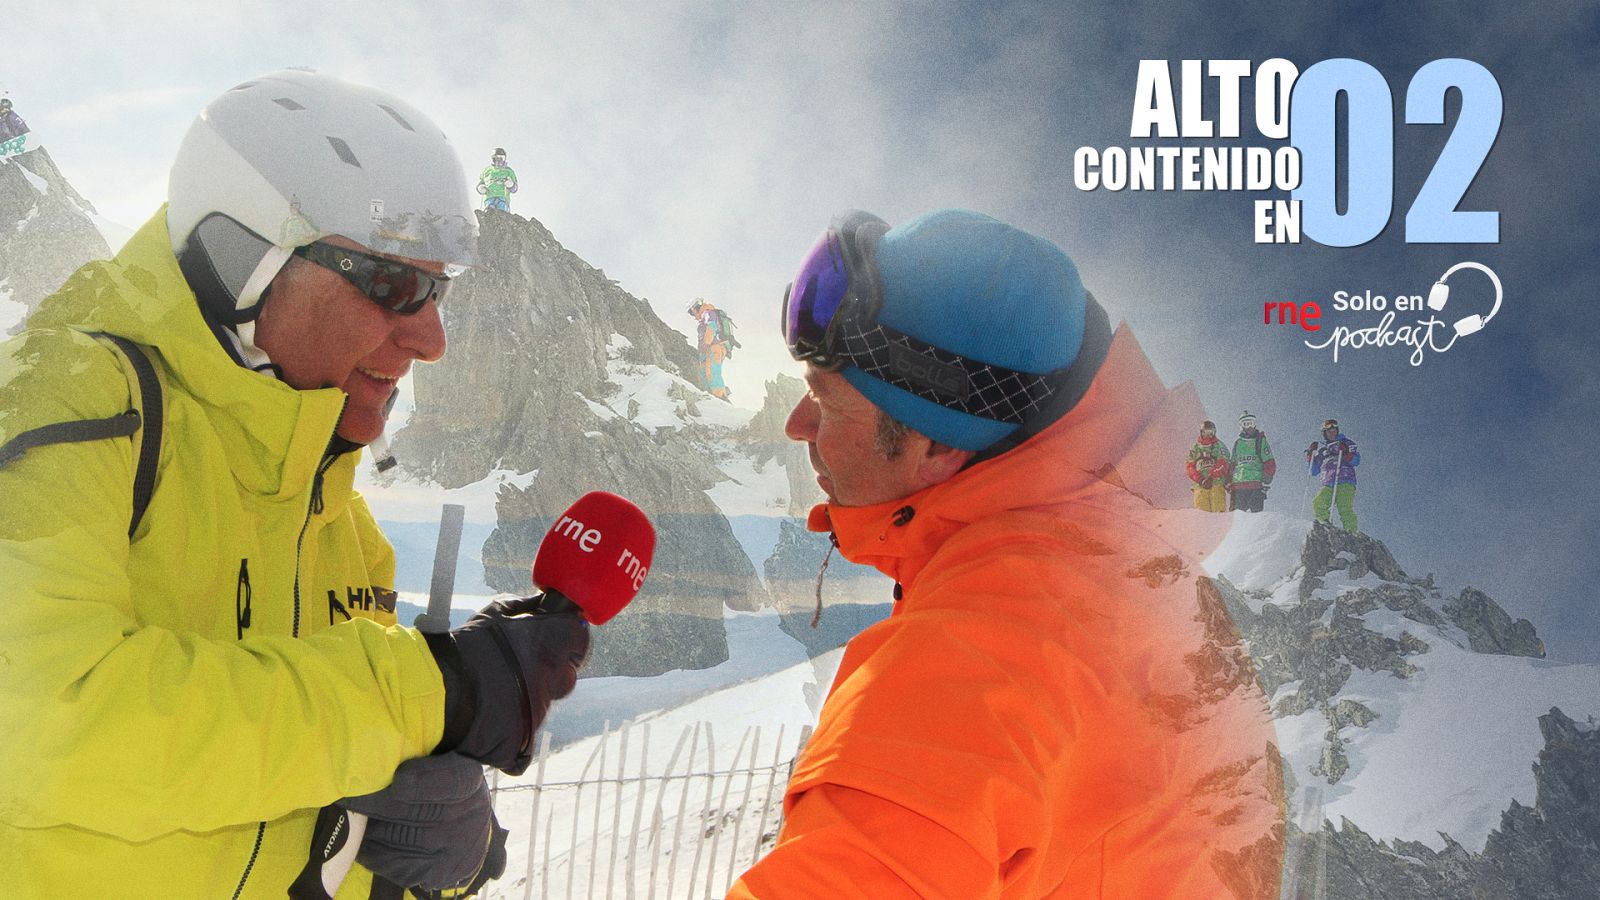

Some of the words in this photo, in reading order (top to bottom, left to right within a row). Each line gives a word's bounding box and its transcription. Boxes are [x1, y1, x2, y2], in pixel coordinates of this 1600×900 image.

[554, 515, 602, 553] rne
[616, 548, 648, 592] rne
[323, 814, 345, 859] ATOMIC
